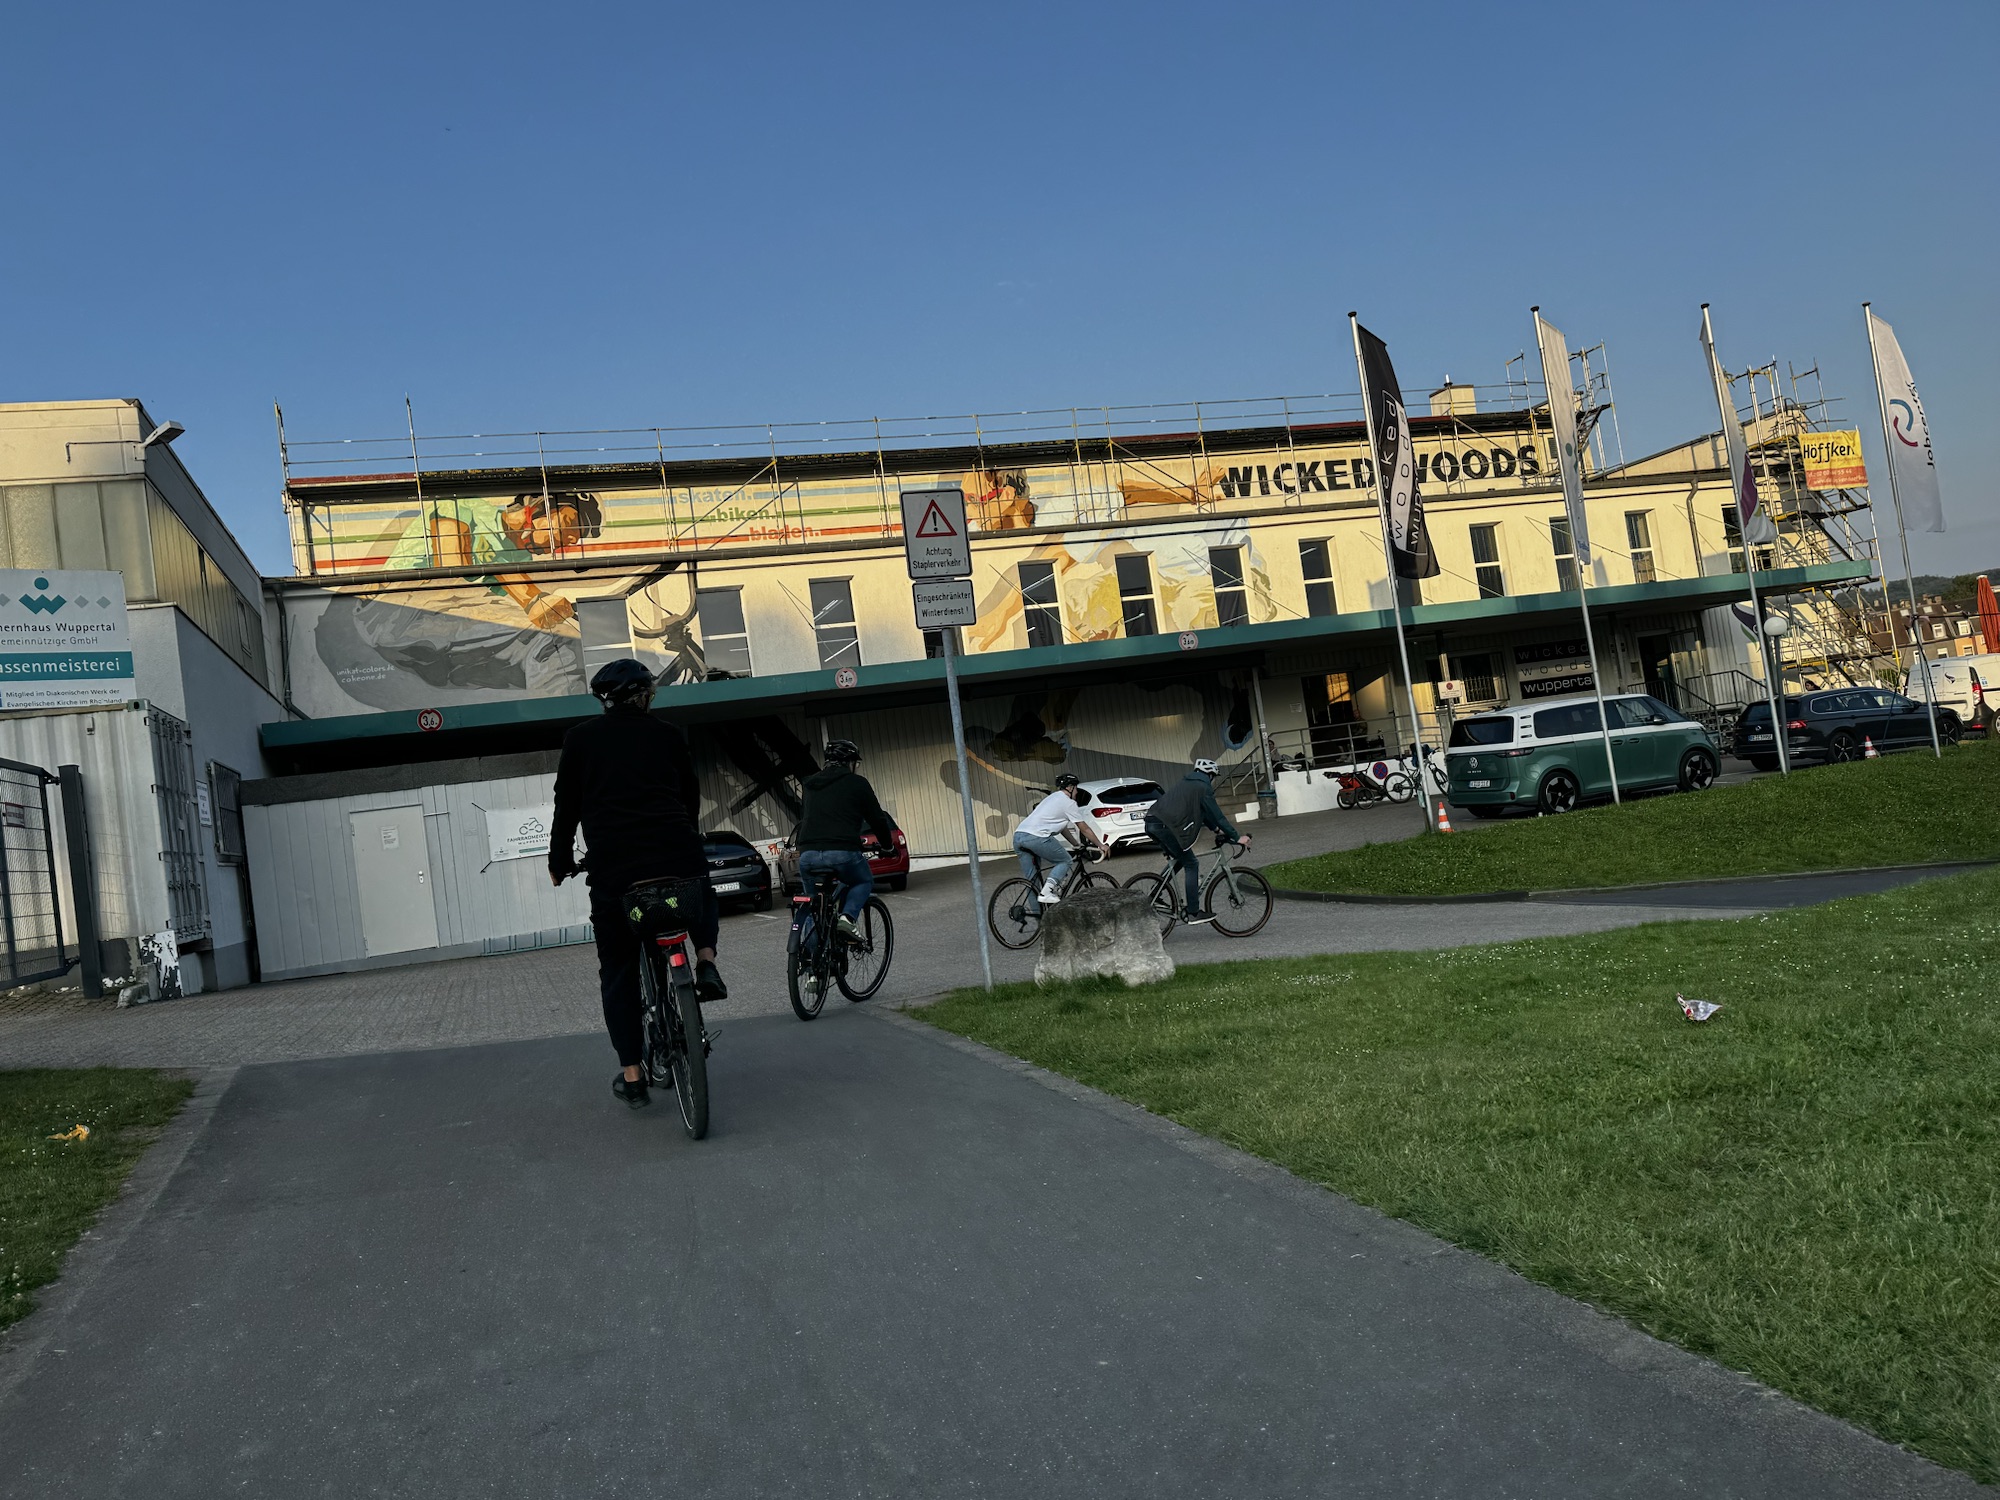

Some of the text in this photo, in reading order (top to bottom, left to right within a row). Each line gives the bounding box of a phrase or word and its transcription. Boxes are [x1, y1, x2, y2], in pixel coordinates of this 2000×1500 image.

[1219, 458, 1376, 498] WICKED
[925, 547, 953, 557] Achtung
[912, 559, 961, 571] Staplerverkehr
[916, 592, 971, 604] Eingeschränkter
[921, 607, 964, 618] Winterdienst
[55, 622, 116, 634] Wuppertal
[70, 636, 98, 645] GmbH
[1518, 643, 1589, 660] wicked
[1521, 659, 1592, 677] woods
[46, 689, 89, 697] Diakonischen
[90, 688, 107, 696] Werk
[7, 700, 55, 708] Evangelischen
